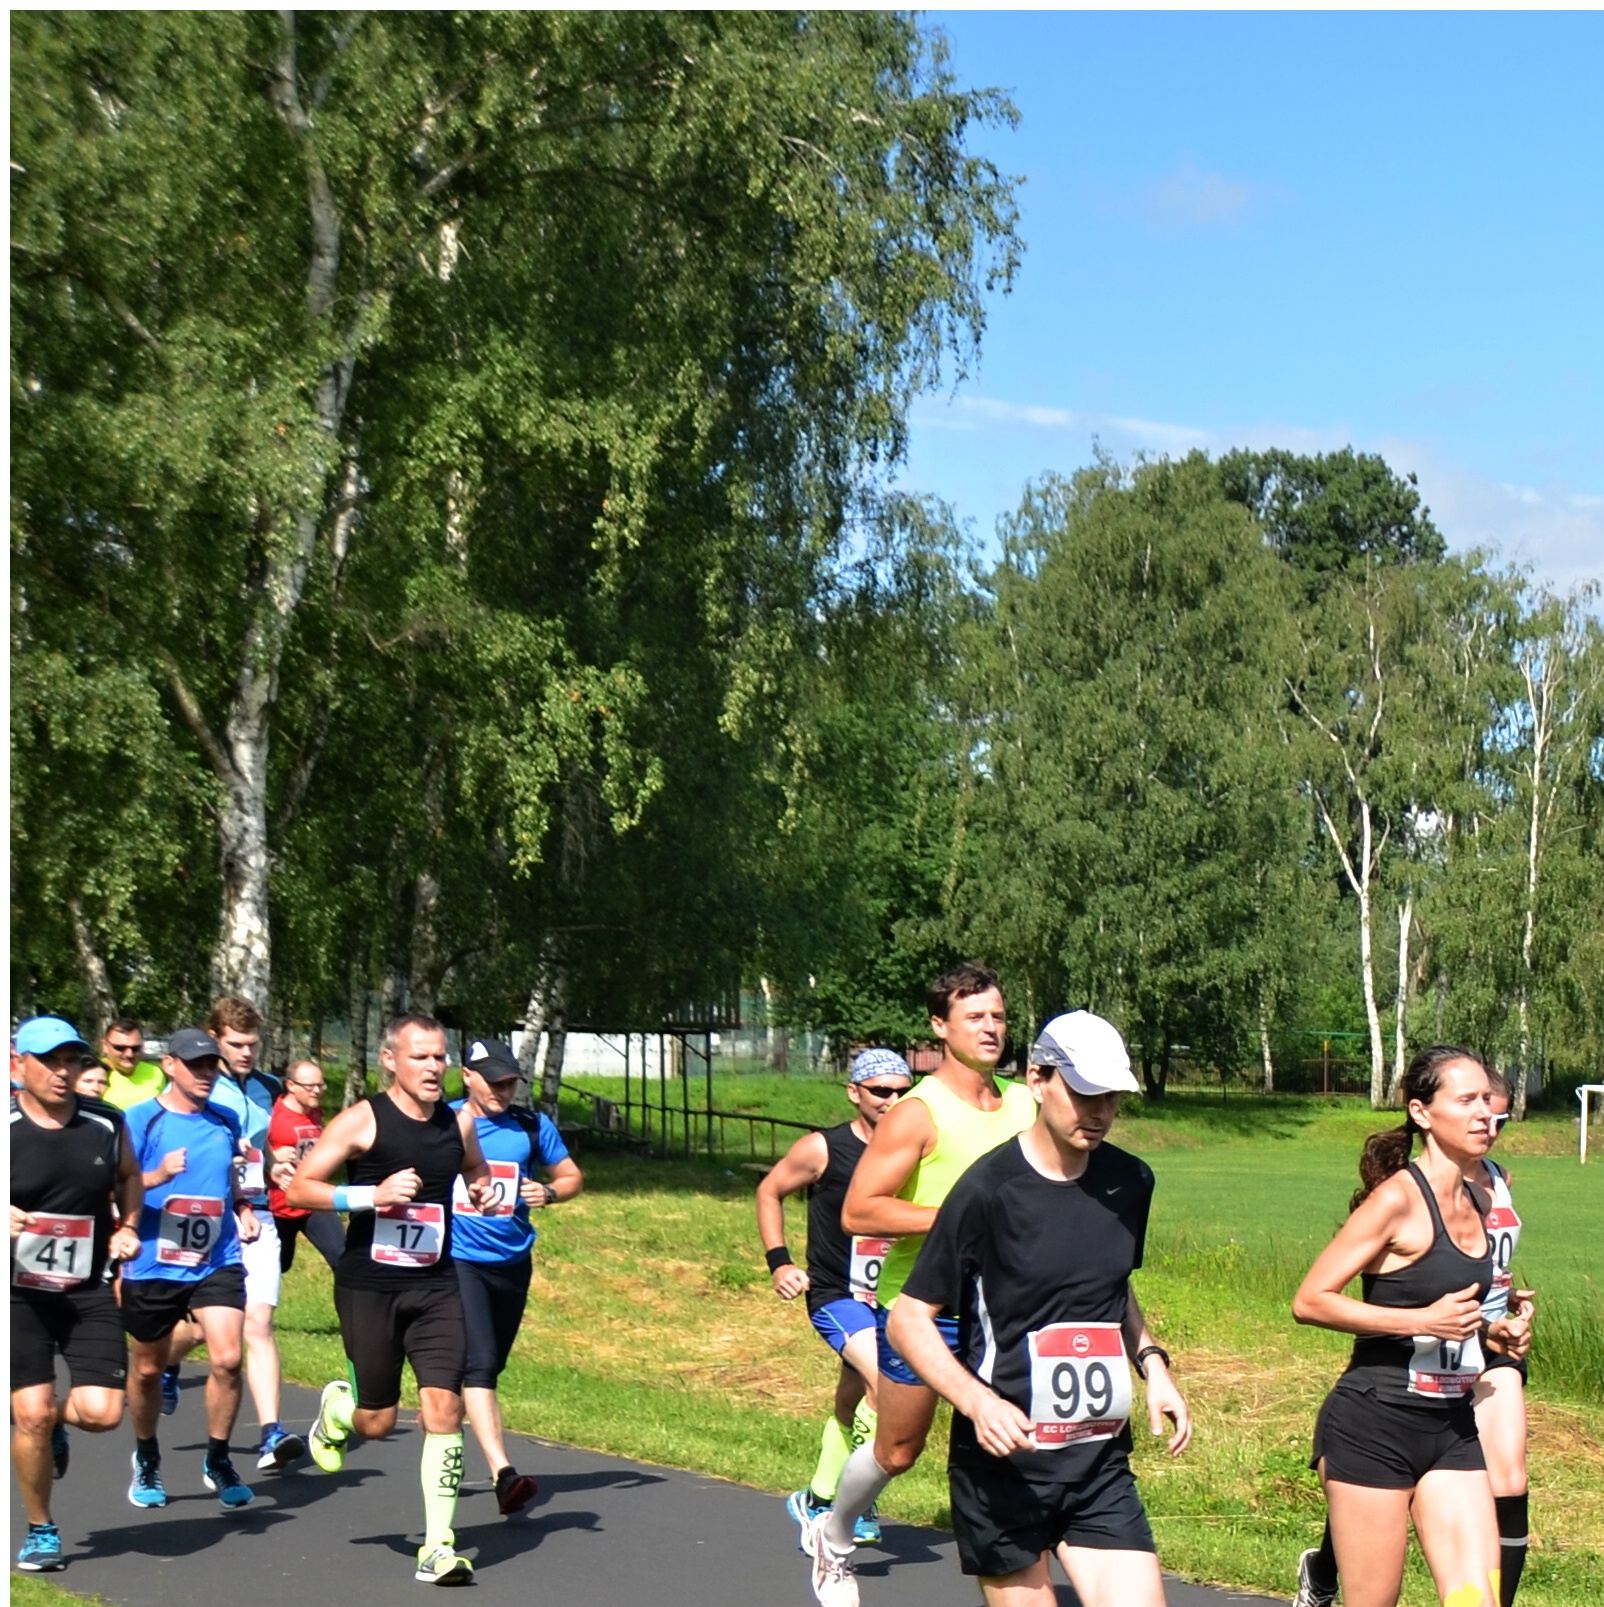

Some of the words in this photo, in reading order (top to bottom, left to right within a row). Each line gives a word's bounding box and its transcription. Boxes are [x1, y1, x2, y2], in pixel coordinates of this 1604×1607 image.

[176, 1217, 210, 1250] 19
[396, 1223, 425, 1250] 17
[35, 1238, 77, 1274] 41
[1051, 1361, 1113, 1419] 99
